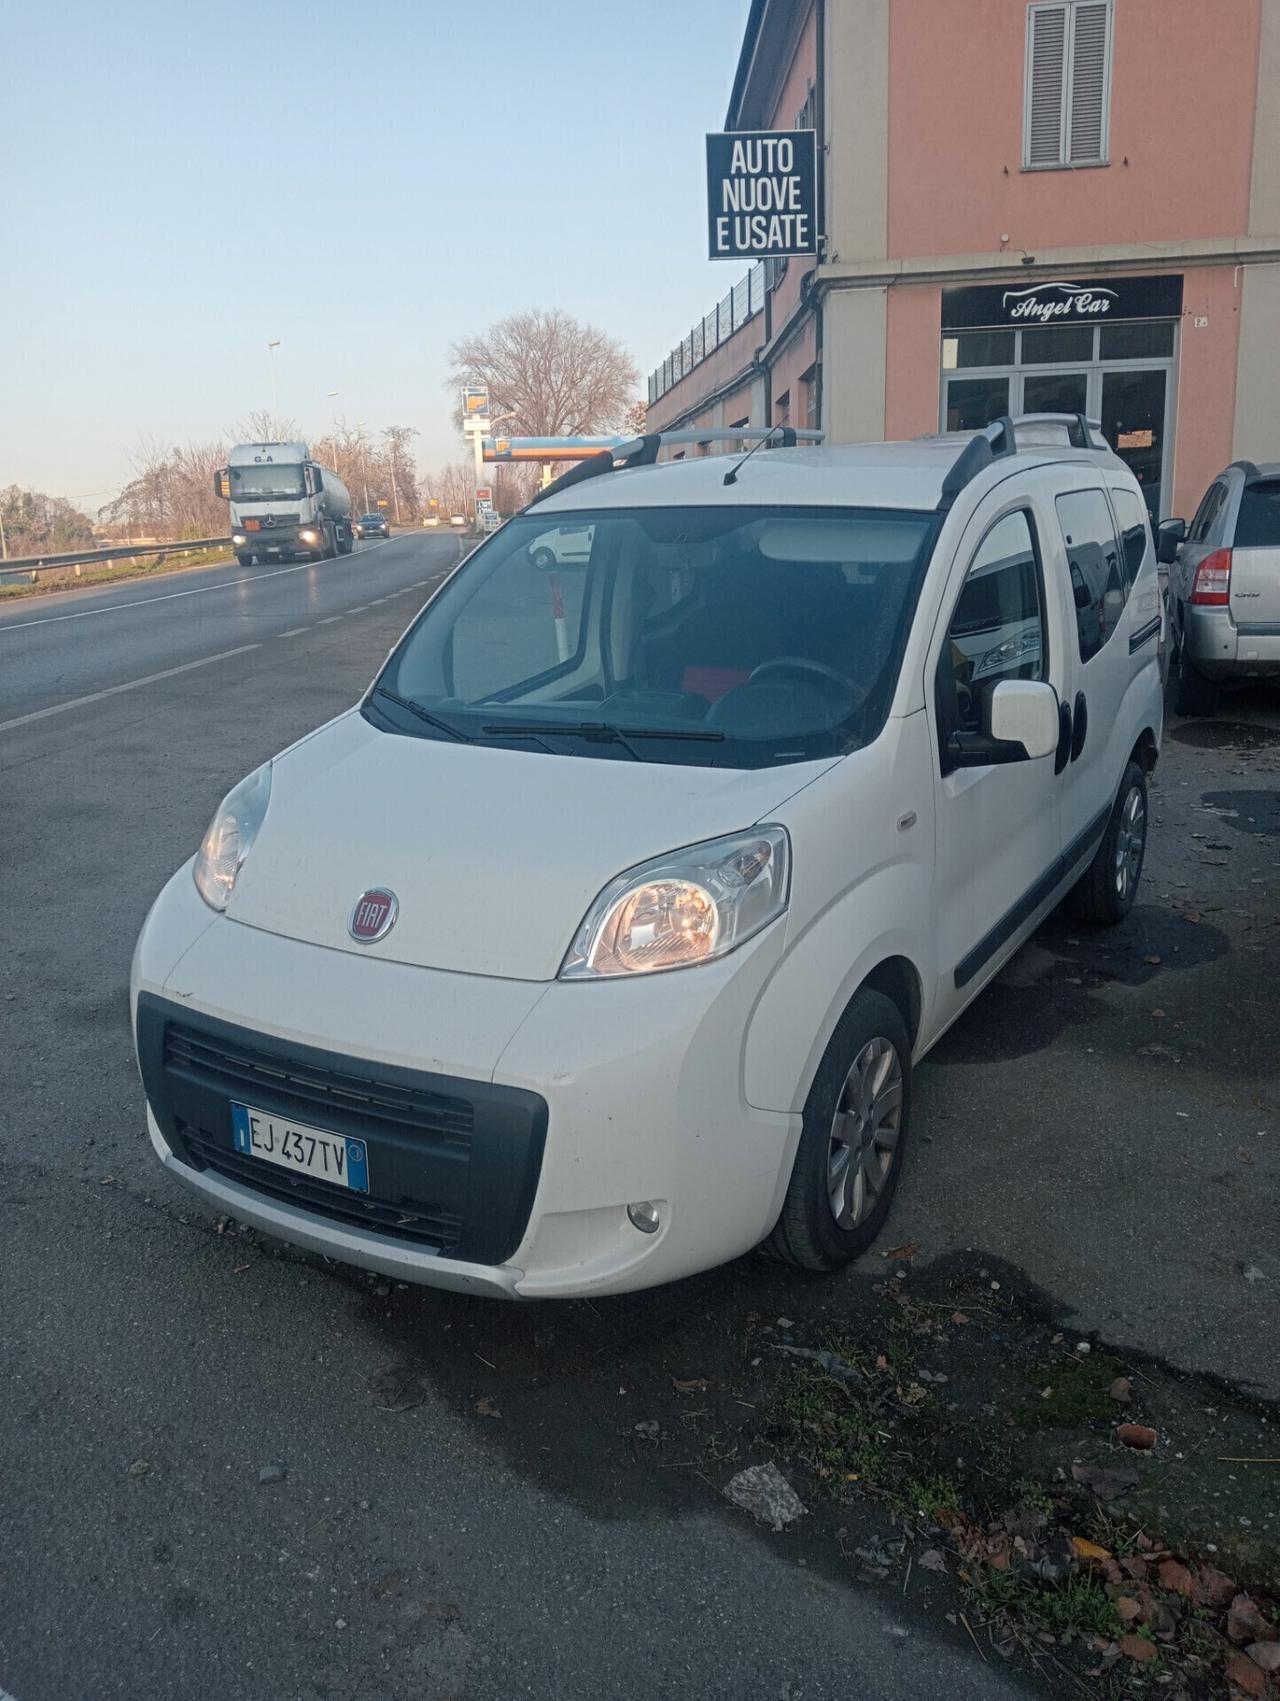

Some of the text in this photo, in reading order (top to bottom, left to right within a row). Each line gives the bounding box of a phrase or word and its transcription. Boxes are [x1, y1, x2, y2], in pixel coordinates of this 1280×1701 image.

[731, 138, 793, 174] AUTO
[722, 176, 801, 212] NUOVE
[717, 214, 808, 251] E USATE
[1011, 293, 1110, 321] Angel Car
[356, 901, 388, 929] FIAT
